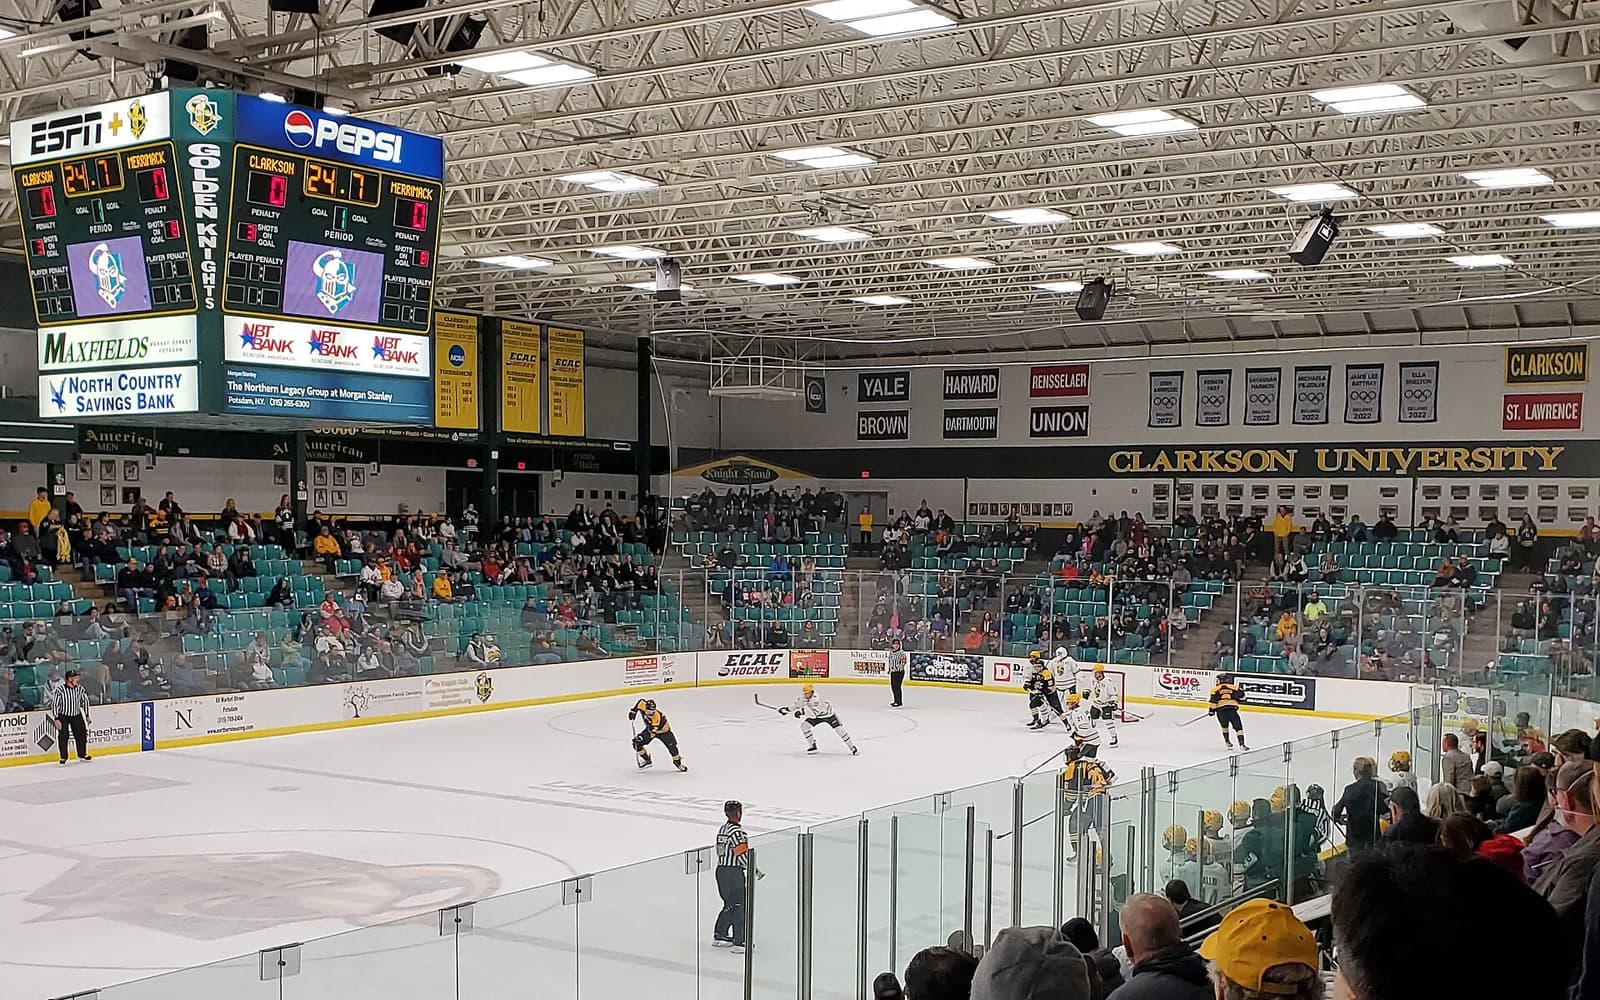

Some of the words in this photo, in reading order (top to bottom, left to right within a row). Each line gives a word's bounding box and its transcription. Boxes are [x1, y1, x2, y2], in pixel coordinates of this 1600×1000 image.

[315, 118, 402, 164] PEPSI
[249, 155, 295, 175] CLARKSON
[188, 143, 221, 219] GOLDEN
[270, 176, 286, 208] 0
[390, 181, 434, 201] MERRIMACK
[76, 206, 90, 215] GOAL
[106, 202, 121, 211] GOAL
[144, 206, 168, 215] PENALTY
[251, 208, 280, 219] PENALTY
[312, 208, 328, 217] GOAL
[352, 214, 368, 224] GOAL
[412, 201, 428, 228] 0
[36, 221, 57, 231] PENALTY
[90, 224, 113, 234] PERIOD
[257, 223, 279, 233] SHOTS
[258, 238, 275, 248] GOAL
[324, 230, 354, 242] PERIOD
[395, 232, 420, 242] PENALTY
[146, 255, 166, 263] PLAYER
[166, 251, 189, 260] PENALTY
[395, 245, 413, 254] SHOTS
[229, 251, 254, 262] PLAYER
[255, 254, 284, 266] PENALTY
[395, 258, 410, 267] GOAL
[32, 268, 49, 277] PLAYER
[49, 266, 69, 275] PENALTY
[196, 223, 218, 310] KNIGHTS
[384, 274, 407, 282] PLAYER
[407, 276, 432, 285] PENALTY
[243, 322, 275, 338] NBT
[311, 329, 341, 344] NBT
[44, 331, 149, 364] MAXFIELDS
[252, 337, 294, 353] BANK
[374, 335, 402, 350] NBT
[320, 342, 359, 359] BANK
[383, 348, 419, 364] BANK
[509, 351, 537, 363] ECAC
[555, 357, 581, 368] ECAC
[1511, 351, 1584, 378] CLARKSON
[69, 376, 114, 394] NORTH
[119, 373, 182, 391] COUNTRY
[863, 377, 905, 397] YALE
[945, 374, 996, 395] HARVARD
[1031, 372, 1088, 390] RENSSELAER
[227, 381, 243, 392] The
[244, 382, 279, 395] Northern
[279, 385, 305, 397] Legacy
[307, 386, 328, 398] Group
[331, 389, 338, 397] at
[339, 389, 367, 402] Morgan
[367, 391, 393, 403] Stanley
[77, 395, 132, 413] SAVINGS
[137, 392, 176, 410] BANK
[1506, 403, 1521, 421] ST.
[1525, 402, 1579, 421] LAWRENCE
[859, 415, 907, 435] BROWN
[944, 416, 996, 432] DARTMOUTH
[1031, 411, 1087, 432] UNION
[96, 442, 120, 451] MEN
[1108, 448, 1298, 475] CLARKSON
[1314, 446, 1566, 475] UNIVERSITY
[705, 467, 738, 479] Knight
[743, 467, 771, 479] Stand
[724, 653, 784, 667] ECAC
[946, 661, 969, 672] Price
[730, 666, 779, 676] HOCKEY
[925, 666, 969, 679] Chopper
[1163, 673, 1198, 687] Save
[1238, 682, 1304, 697] casella
[0, 714, 28, 727] rnold
[143, 705, 151, 741] CCM
[175, 708, 193, 730] N
